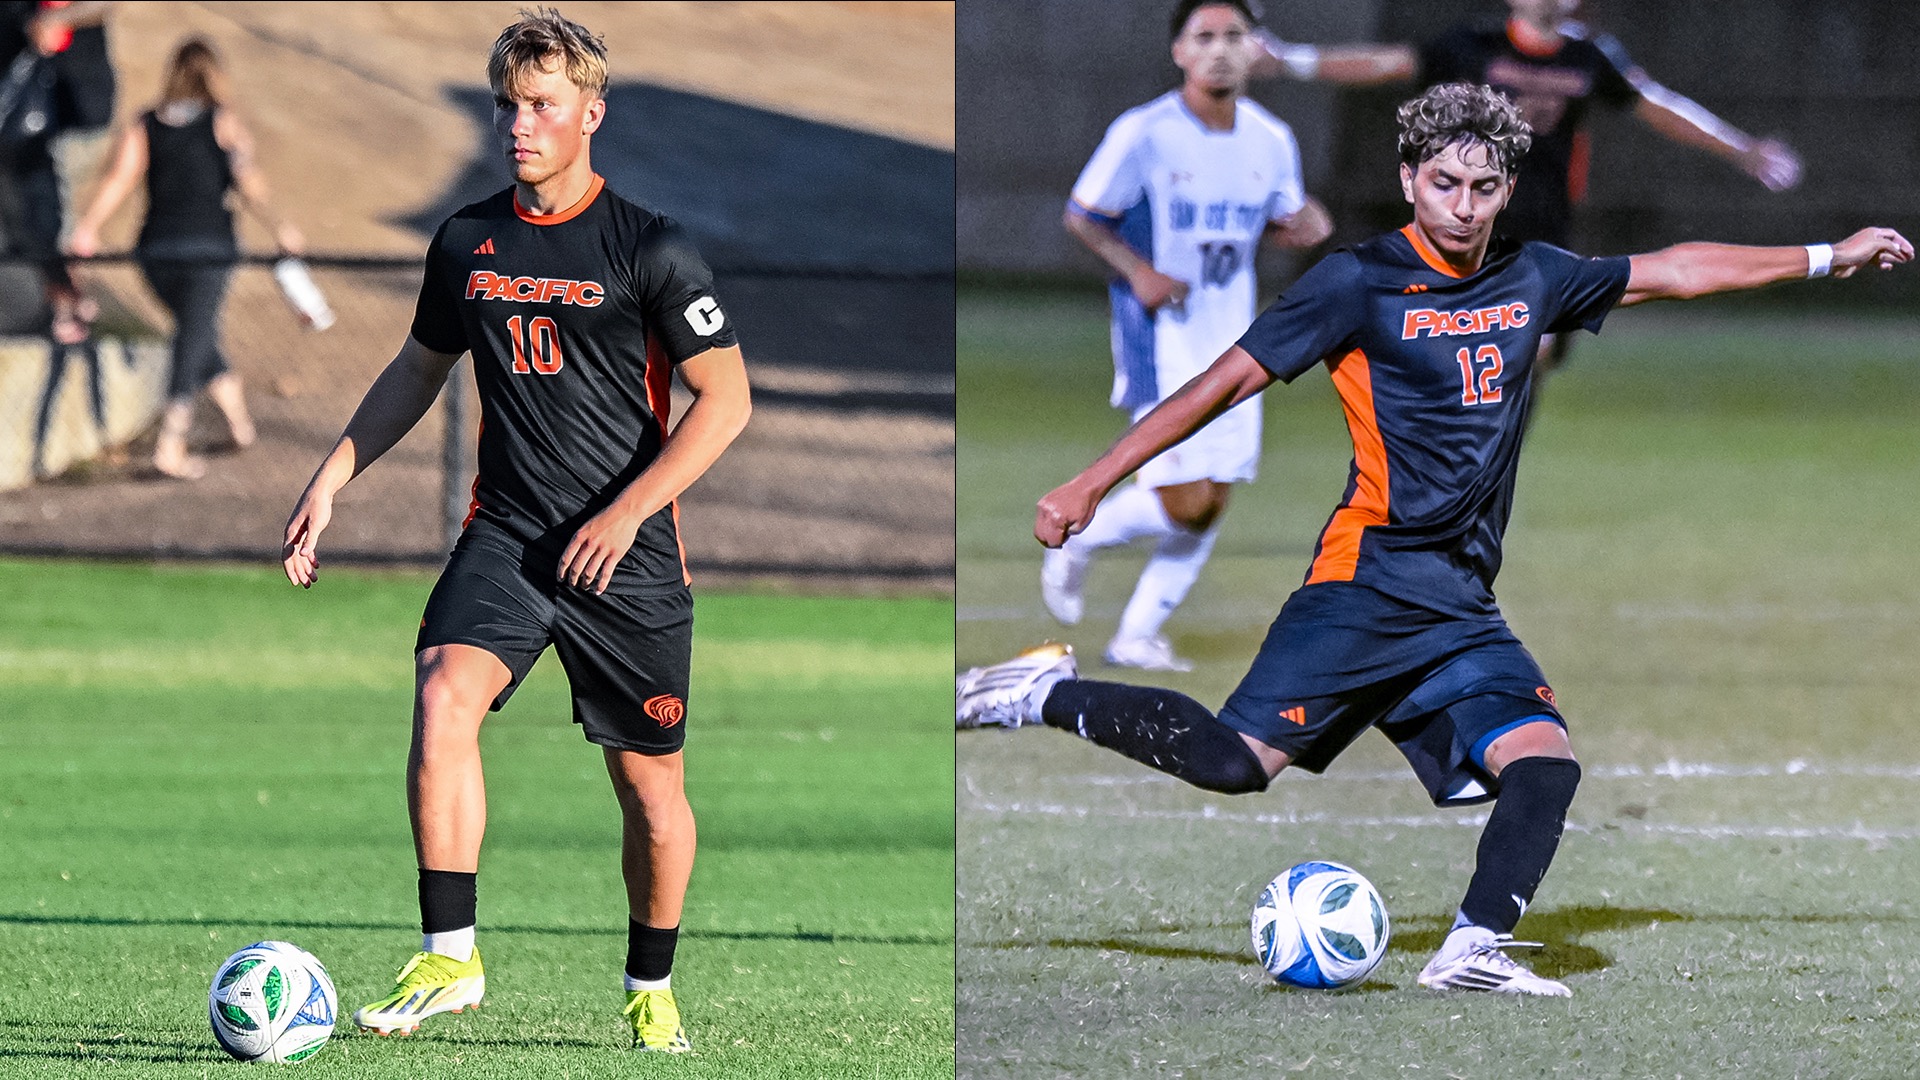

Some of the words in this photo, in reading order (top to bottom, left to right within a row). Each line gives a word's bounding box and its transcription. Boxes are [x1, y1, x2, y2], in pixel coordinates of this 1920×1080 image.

[465, 271, 605, 307] PACIFIC
[683, 296, 725, 337] C
[1402, 302, 1530, 340] PACIFIC
[506, 315, 564, 375] 10
[1456, 344, 1503, 406] 12
